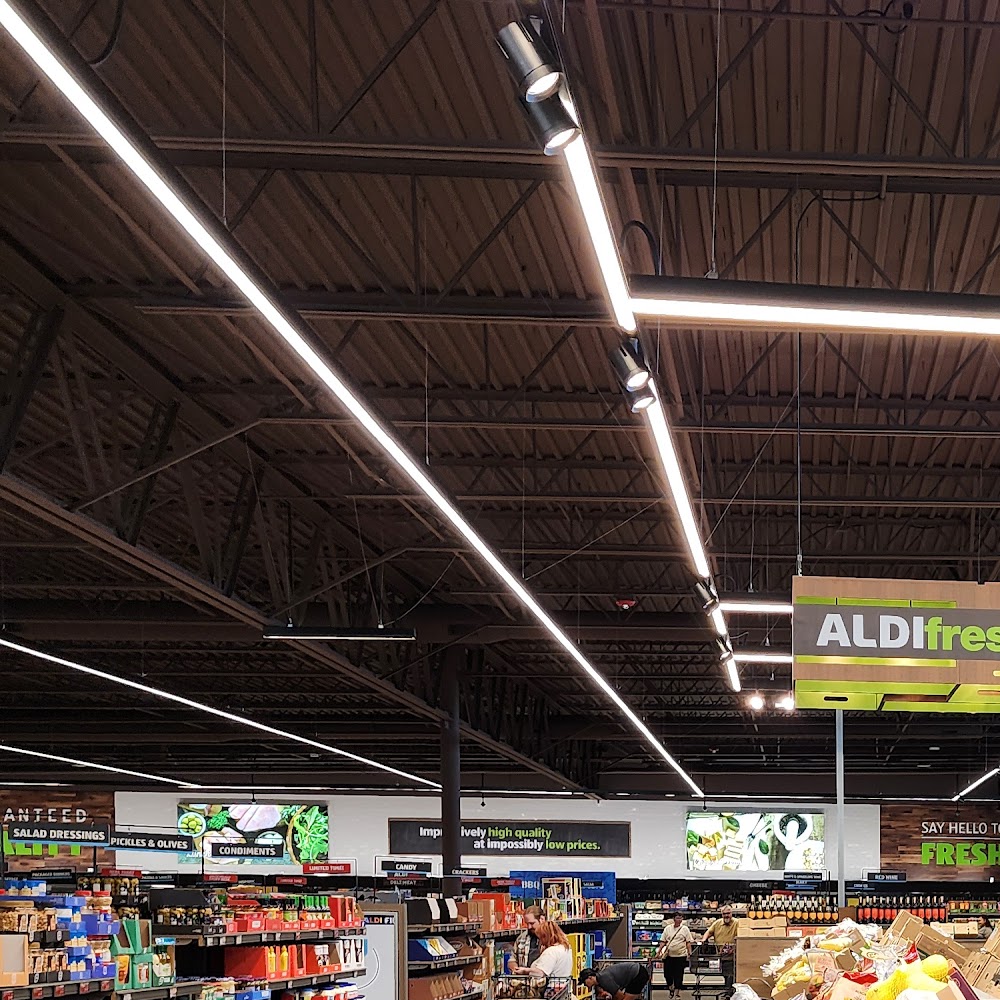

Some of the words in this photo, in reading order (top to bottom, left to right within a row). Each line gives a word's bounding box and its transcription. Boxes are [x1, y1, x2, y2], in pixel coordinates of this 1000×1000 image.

[13, 828, 48, 839] SALAD
[49, 829, 106, 841] DRESSINGS
[488, 827, 513, 839] high
[514, 827, 552, 839] quality
[921, 822, 947, 835] SAY
[948, 822, 988, 835] HELLO
[110, 837, 147, 847] PICKLES
[148, 839, 156, 848] &
[157, 840, 189, 849] OLIVES
[474, 840, 485, 849] at
[486, 839, 544, 852] impossibly
[545, 840, 565, 850] low
[566, 840, 601, 852] prices.
[219, 846, 277, 856] CONDIMENTS
[521, 879, 541, 891] BBQ
[364, 916, 383, 924] ALDI
